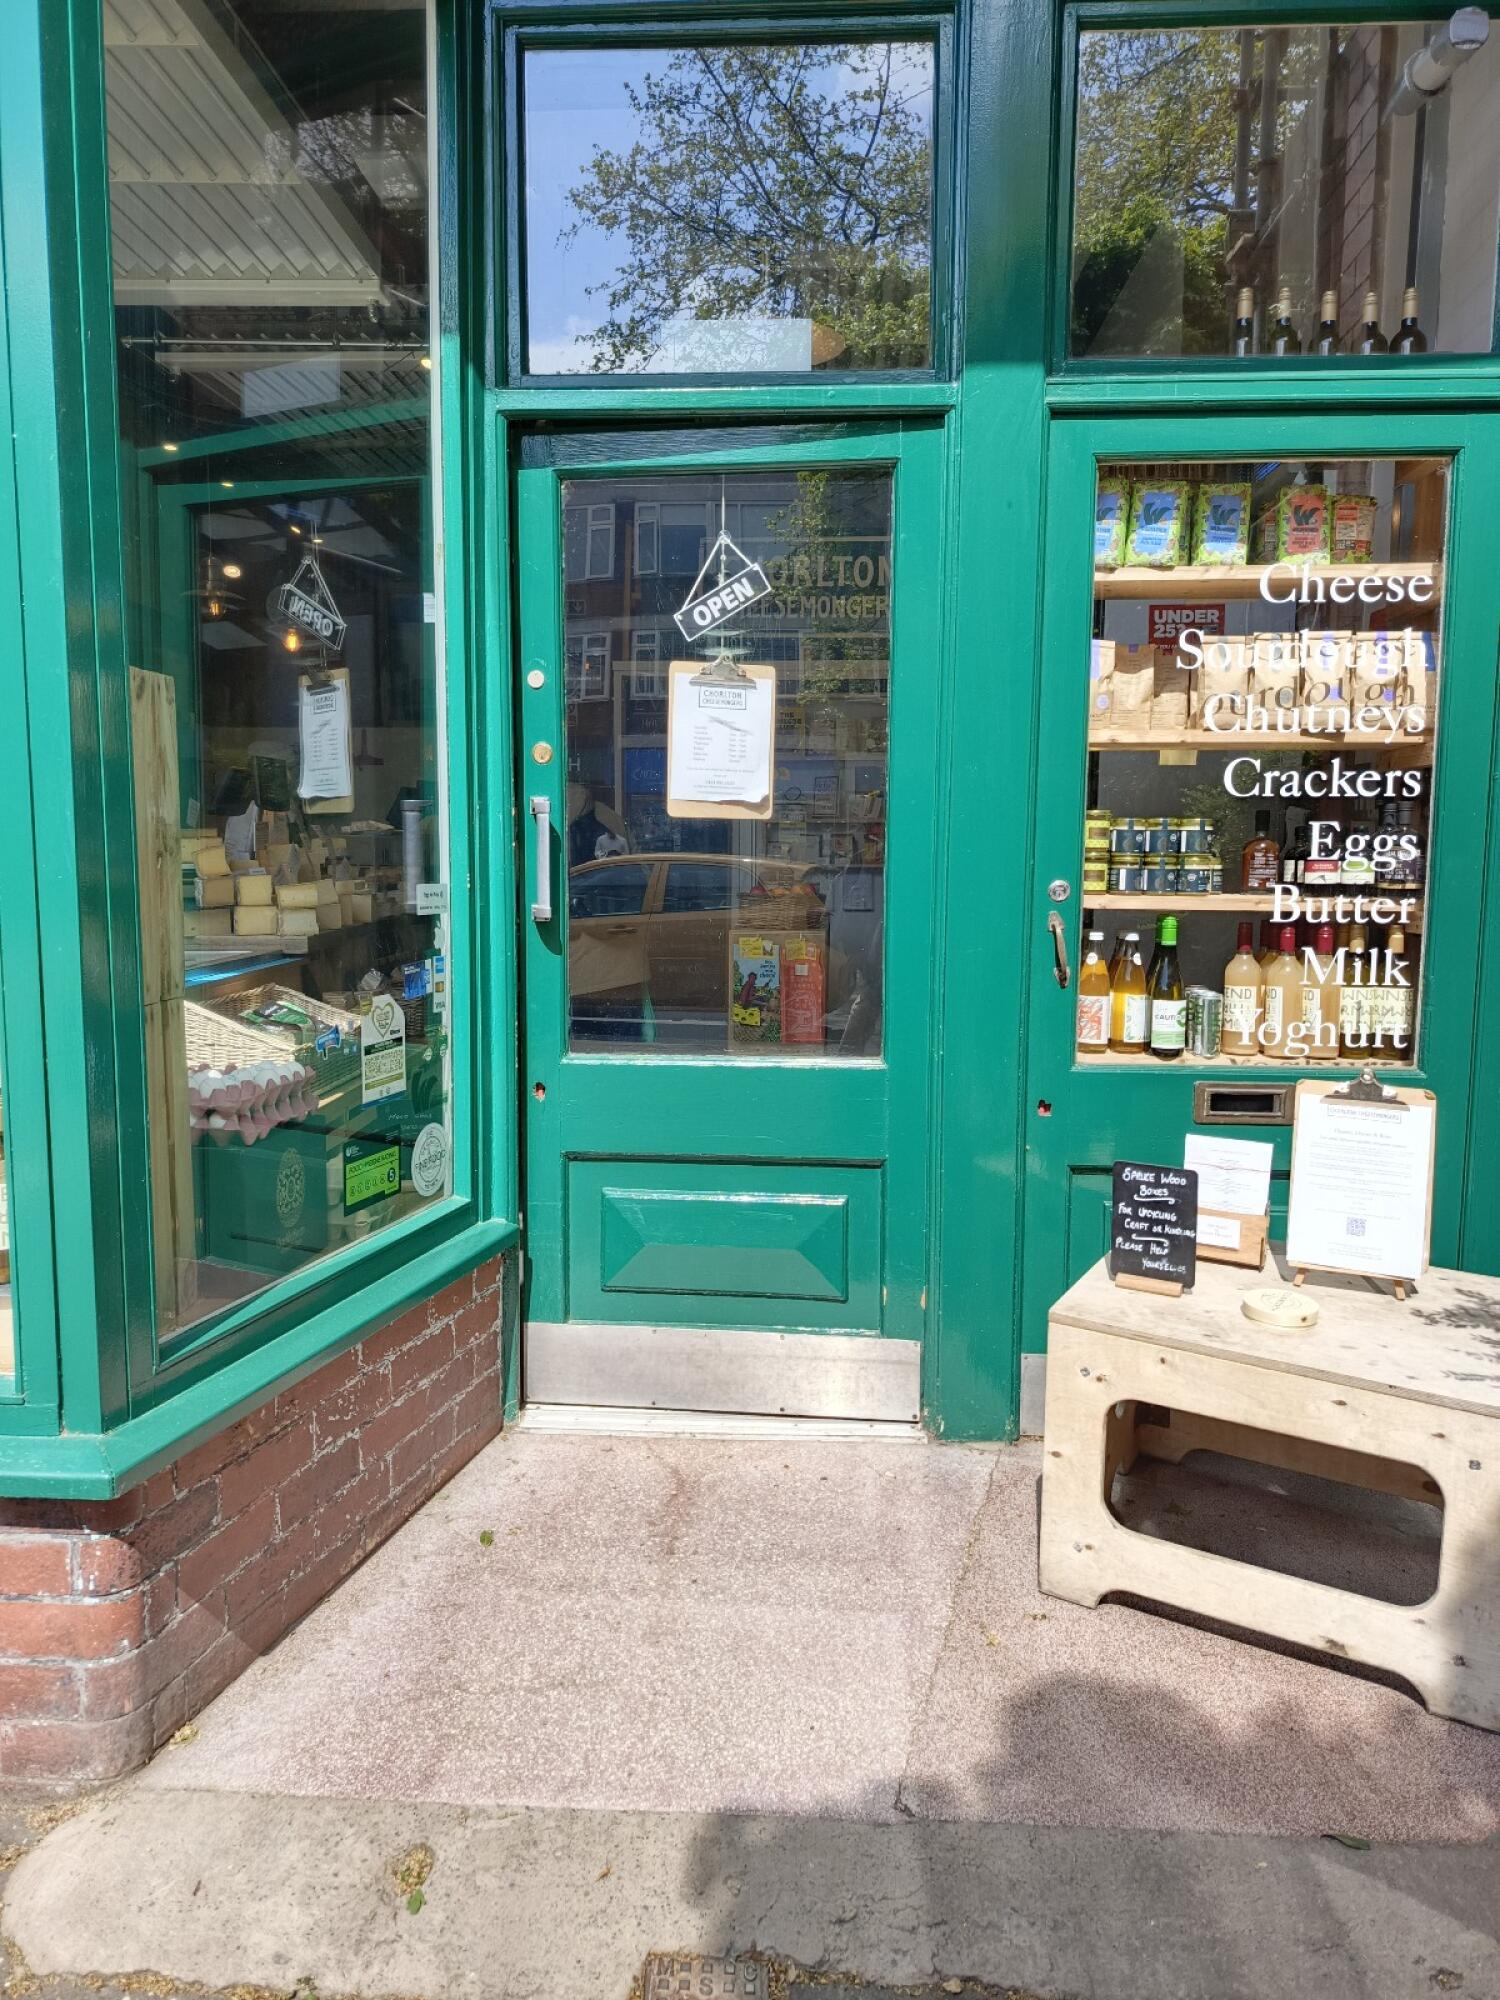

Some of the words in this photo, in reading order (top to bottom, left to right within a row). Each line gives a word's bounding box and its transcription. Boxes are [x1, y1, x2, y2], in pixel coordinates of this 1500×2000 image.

[693, 577, 755, 627] OPEN
[1260, 563, 1434, 604] Cheese
[1153, 609, 1220, 624] UNDER
[1176, 628, 1428, 678] Sourdough
[1204, 694, 1426, 744] Chutneys
[1224, 757, 1422, 798] Crackers
[1307, 821, 1419, 871] Eggs
[1270, 884, 1415, 924] Butter
[1299, 947, 1411, 987] Milk
[1237, 1008, 1407, 1057] Yoghurt
[1122, 1167, 1155, 1182] SPRUCE
[1160, 1172, 1187, 1186] WOOD
[1139, 1184, 1169, 1197] BOXES
[1118, 1202, 1132, 1216] FOR
[1125, 1218, 1150, 1232] CRAFT
[1115, 1237, 1143, 1252] PLEASE
[1149, 1243, 1171, 1256] HELP
[699, 1976, 714, 1996] S
